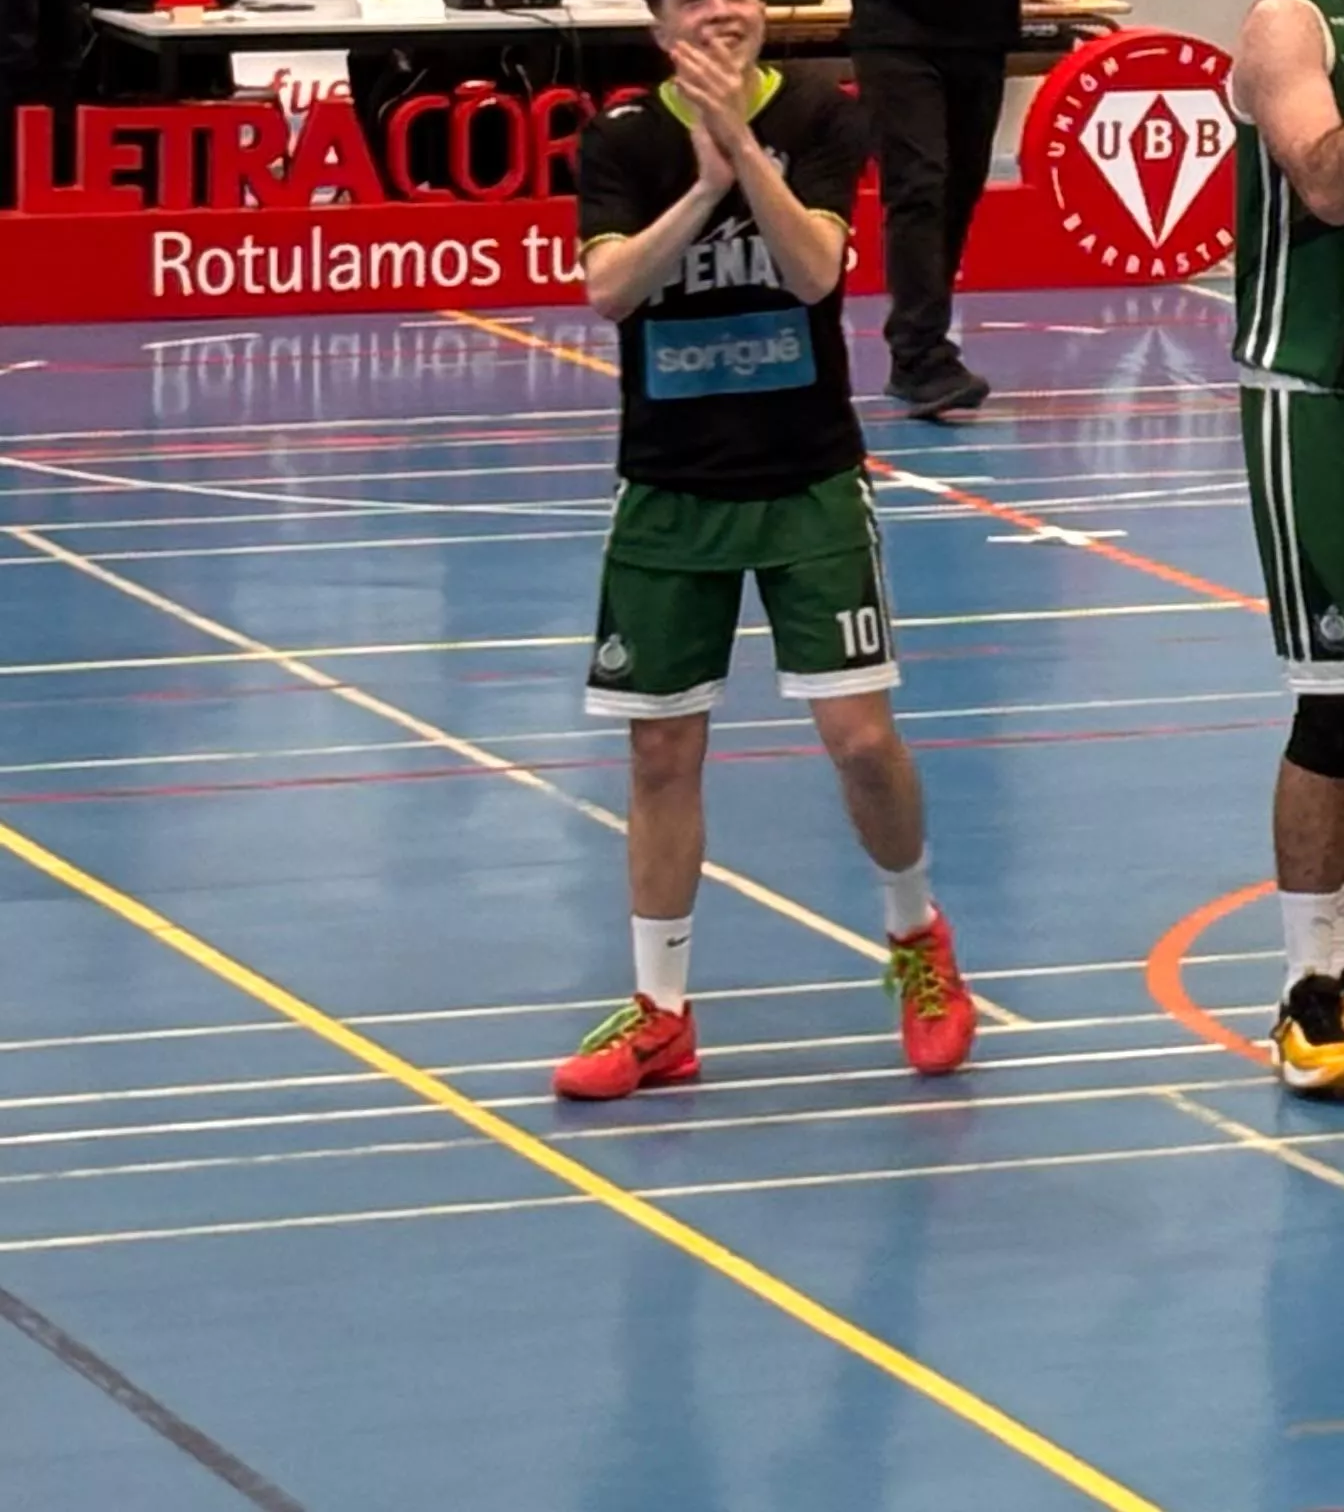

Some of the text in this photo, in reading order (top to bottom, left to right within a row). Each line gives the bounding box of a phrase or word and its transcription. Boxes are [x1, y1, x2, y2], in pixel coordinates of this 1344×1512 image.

[1096, 118, 1222, 161] UBB
[152, 225, 501, 296] Rotulamos
[835, 609, 880, 656] 10
